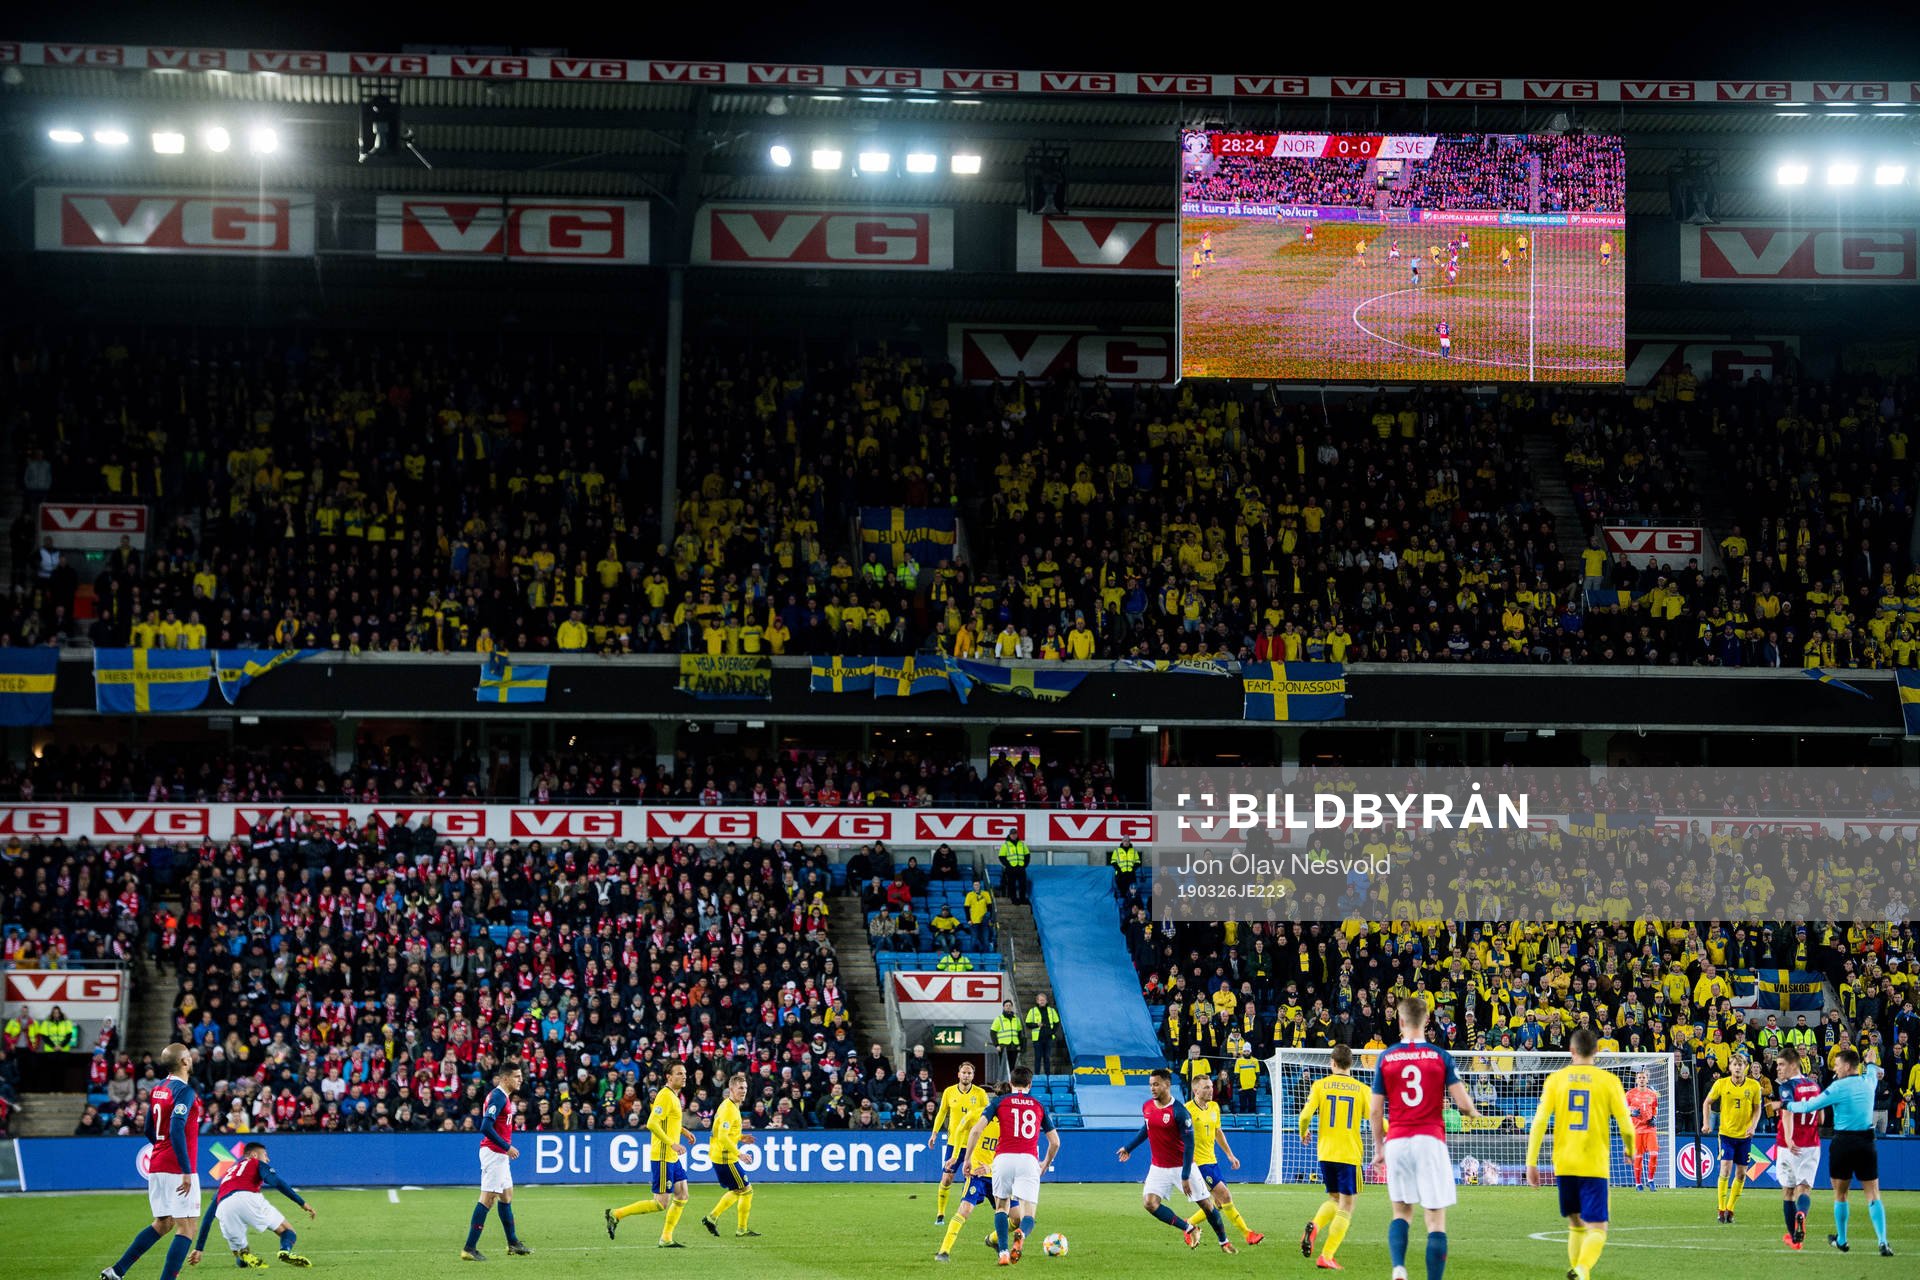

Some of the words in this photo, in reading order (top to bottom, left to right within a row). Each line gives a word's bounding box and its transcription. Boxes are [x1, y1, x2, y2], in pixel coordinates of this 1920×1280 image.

[48, 48, 119, 64] VG
[152, 51, 223, 66] VG
[254, 53, 323, 70] VG
[353, 56, 423, 73] VG
[454, 58, 524, 76] VG
[553, 61, 622, 78] VG
[652, 64, 721, 81] VG
[752, 66, 818, 83] VG
[850, 69, 917, 86] VG
[947, 72, 1015, 89] VG
[1045, 74, 1111, 91] VG
[1141, 76, 1208, 93] VG
[1238, 78, 1304, 95] VG
[1334, 79, 1400, 96] VG
[1430, 81, 1497, 97] VG
[1527, 81, 1593, 98] VG
[1624, 83, 1690, 99] VG
[1720, 83, 1787, 99] VG
[1816, 84, 1884, 99] VG
[1221, 138, 1265, 152] 28:24
[1283, 140, 1315, 153] NOR
[1395, 141, 1424, 154] SVE
[1182, 203, 1199, 213] ditt
[1202, 204, 1226, 214] kurs
[1228, 205, 1241, 217] på
[70, 199, 278, 247] VG
[409, 204, 613, 255] VG
[717, 212, 917, 261] VG
[1707, 231, 1904, 276] VG
[967, 332, 1168, 379] VG
[46, 508, 142, 530] VG
[1607, 530, 1696, 551] VG
[1278, 681, 1340, 692] JONASSON
[99, 810, 203, 833] VG
[514, 812, 616, 835] VG
[650, 813, 750, 836] VG
[786, 814, 885, 837] VG
[919, 815, 1018, 838] VG
[1054, 816, 1152, 839] VG
[7, 975, 118, 1000] VG
[896, 975, 999, 1001] VG
[1774, 983, 1810, 994] VALSKOG
[1323, 1080, 1361, 1092] CLAESSON
[1400, 1064, 1424, 1107] 3
[961, 1106, 968, 1114] 4
[1325, 1094, 1355, 1129] 17
[1569, 1090, 1590, 1131] 9
[1734, 1098, 1741, 1109] 3
[153, 1103, 165, 1140] 2
[1010, 1107, 1037, 1139] 18
[981, 1136, 998, 1151] 20
[537, 1134, 592, 1174] Bli
[221, 1160, 250, 1185] 21
